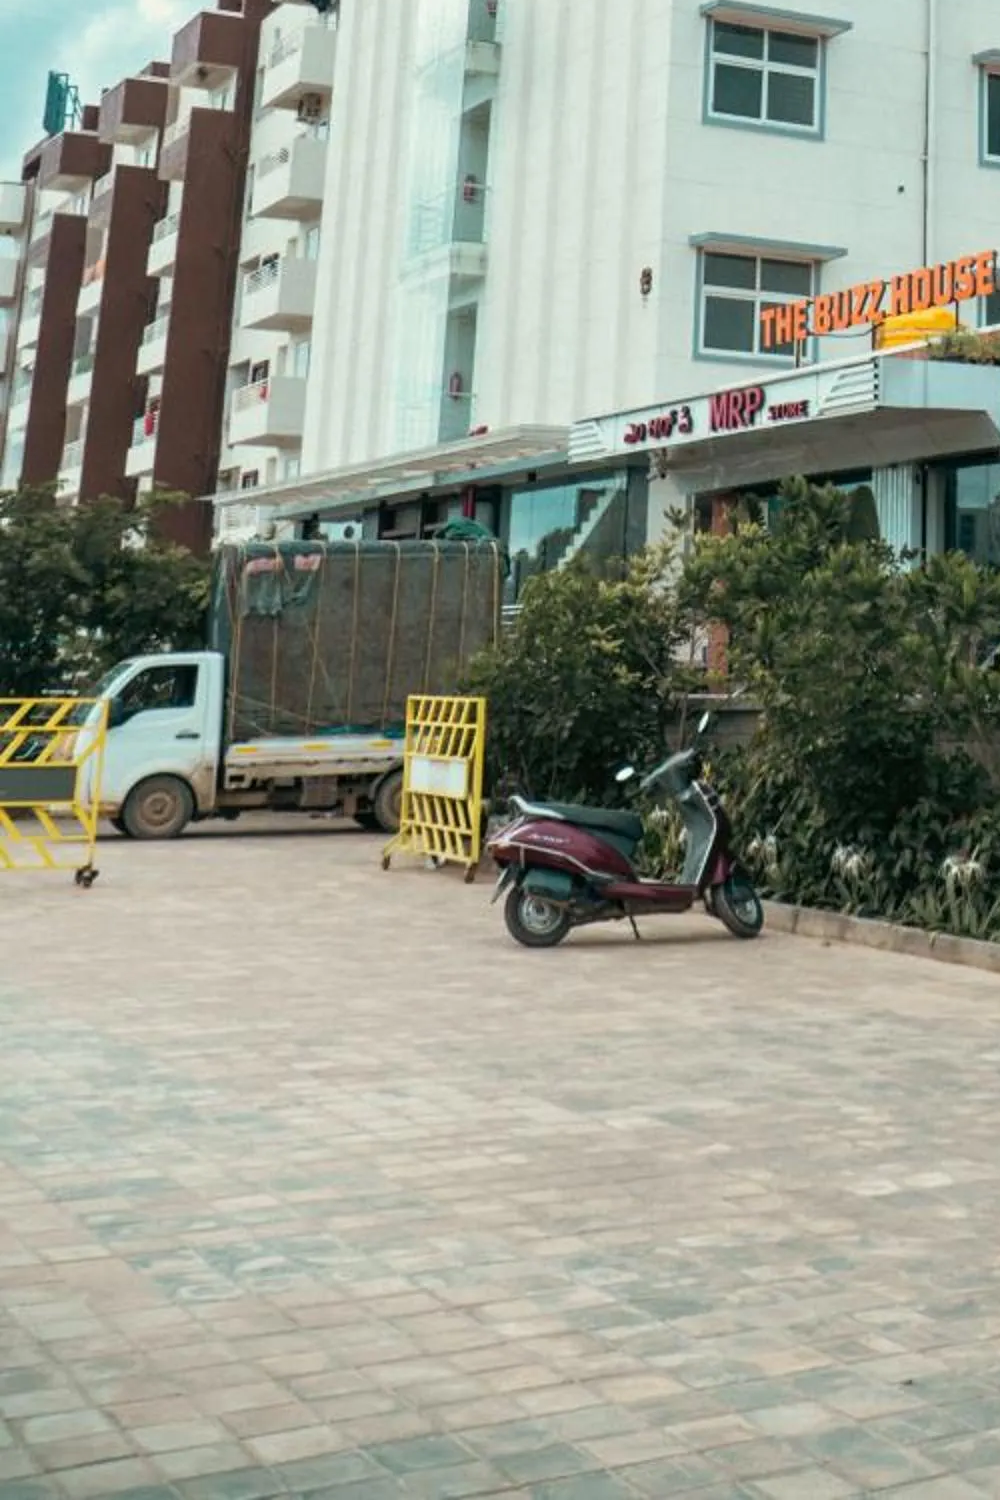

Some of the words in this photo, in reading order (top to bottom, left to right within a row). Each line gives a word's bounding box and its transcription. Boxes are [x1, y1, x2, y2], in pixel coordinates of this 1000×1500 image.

[760, 300, 808, 347] THE
[814, 279, 886, 333] BUZZ
[888, 250, 998, 315] HOUSE
[710, 386, 766, 432] MRP
